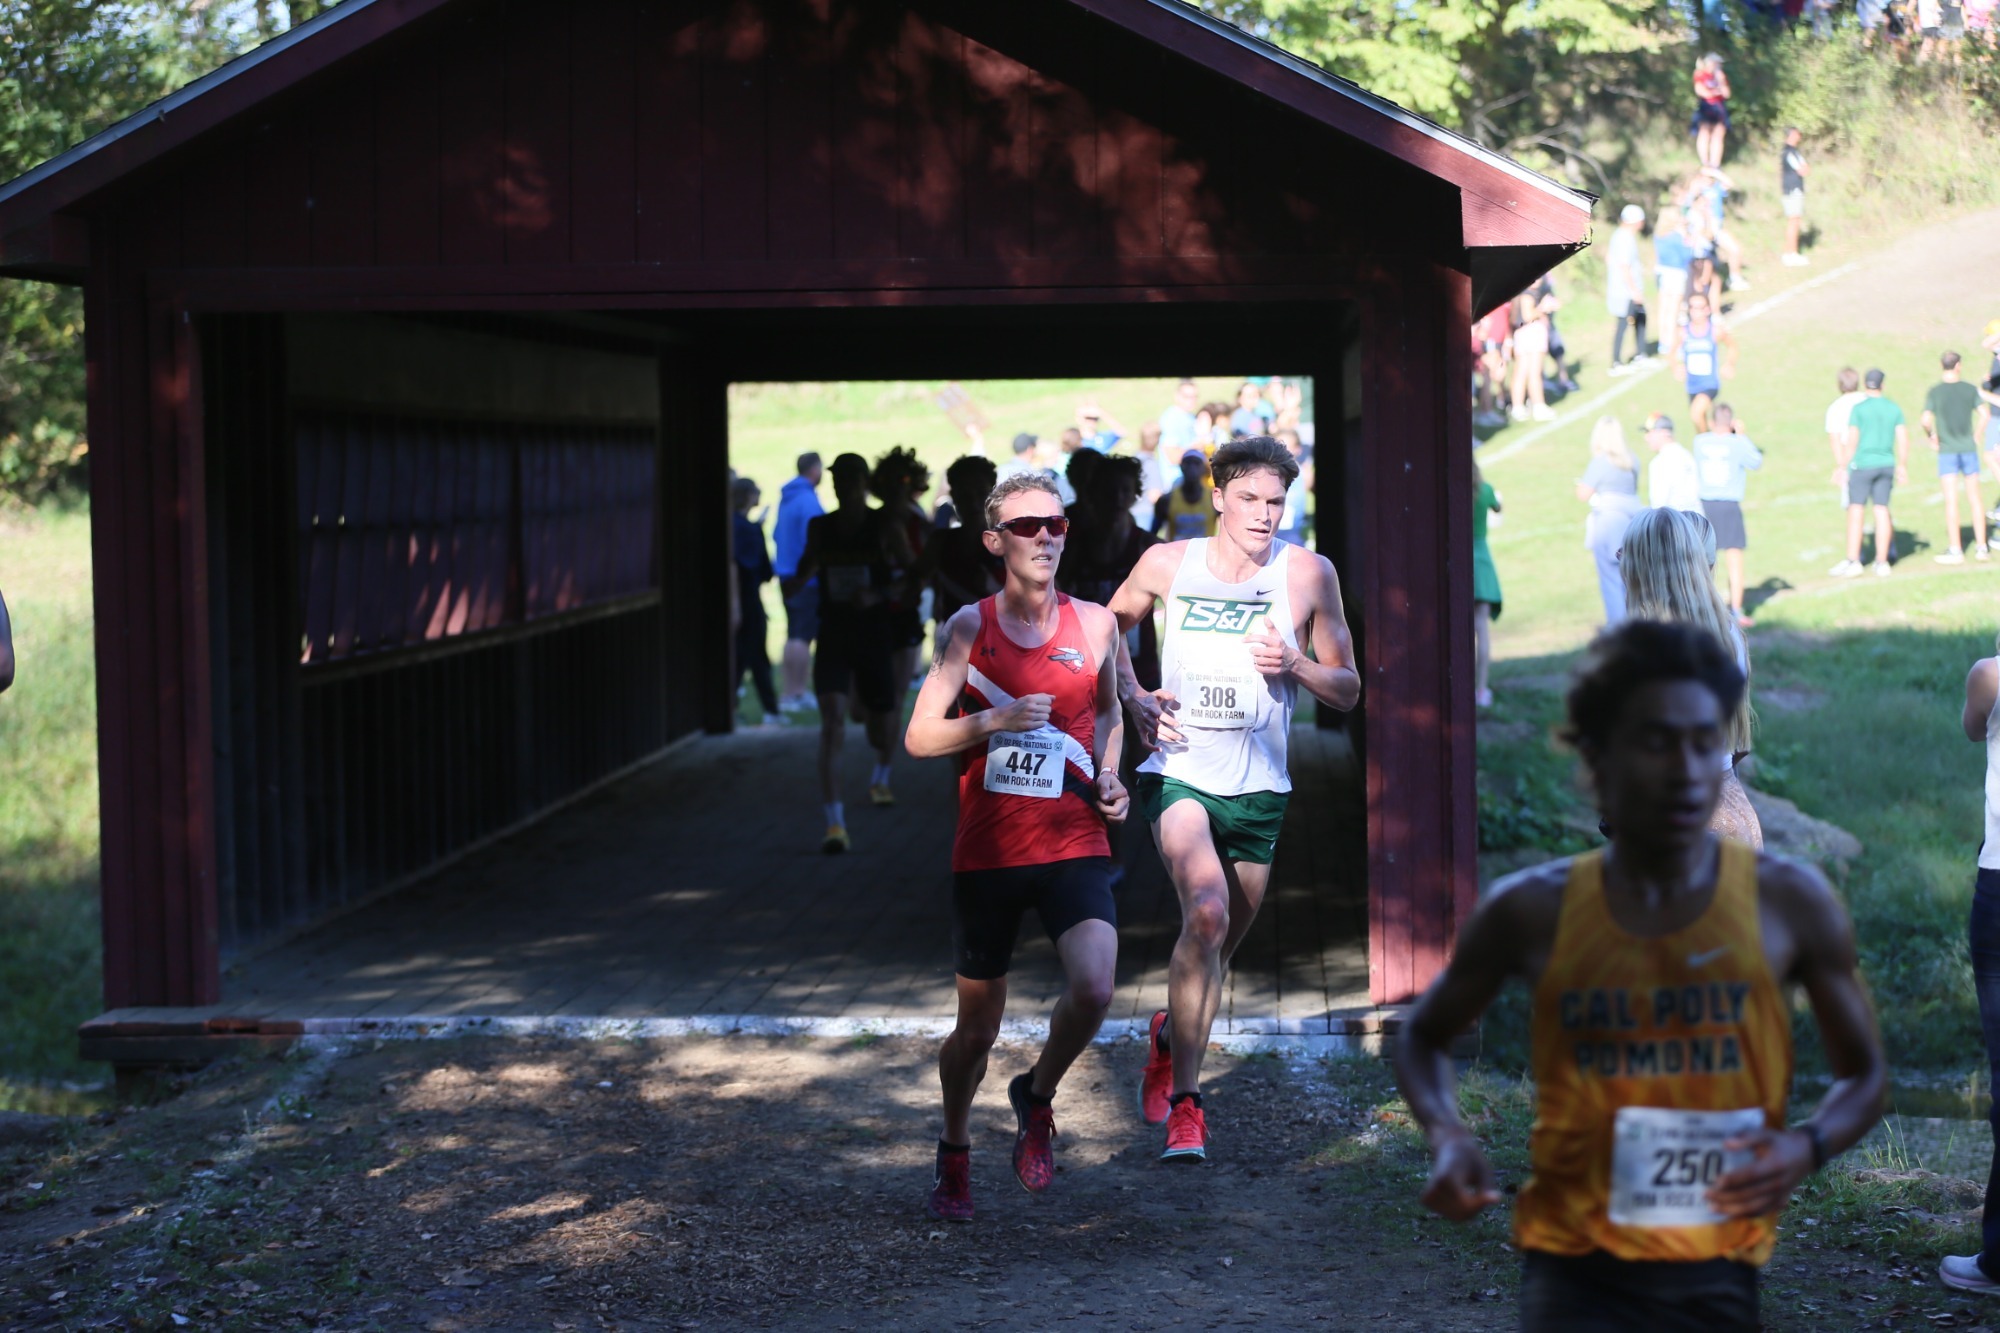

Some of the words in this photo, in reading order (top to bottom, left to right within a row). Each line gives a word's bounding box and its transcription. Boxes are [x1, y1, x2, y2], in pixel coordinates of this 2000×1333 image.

[1180, 597, 1270, 633] S&T
[1203, 674, 1242, 683] PRENATIONALS
[1199, 685, 1237, 709] 308
[1191, 708, 1203, 717] RIM
[1204, 709, 1224, 719] ROCK
[1224, 710, 1245, 720] FARM
[1004, 738, 1011, 746] D2
[1012, 739, 1052, 749] PRE-NATIONALS
[1006, 751, 1047, 775] 447
[995, 773, 1009, 784] RIM
[1011, 775, 1031, 786] ROCK
[1033, 778, 1052, 788] FARM
[1562, 989, 1637, 1029] CAL
[1655, 983, 1749, 1026] POLY
[1576, 1036, 1743, 1077] POMONA
[1652, 1148, 1724, 1187] 250
